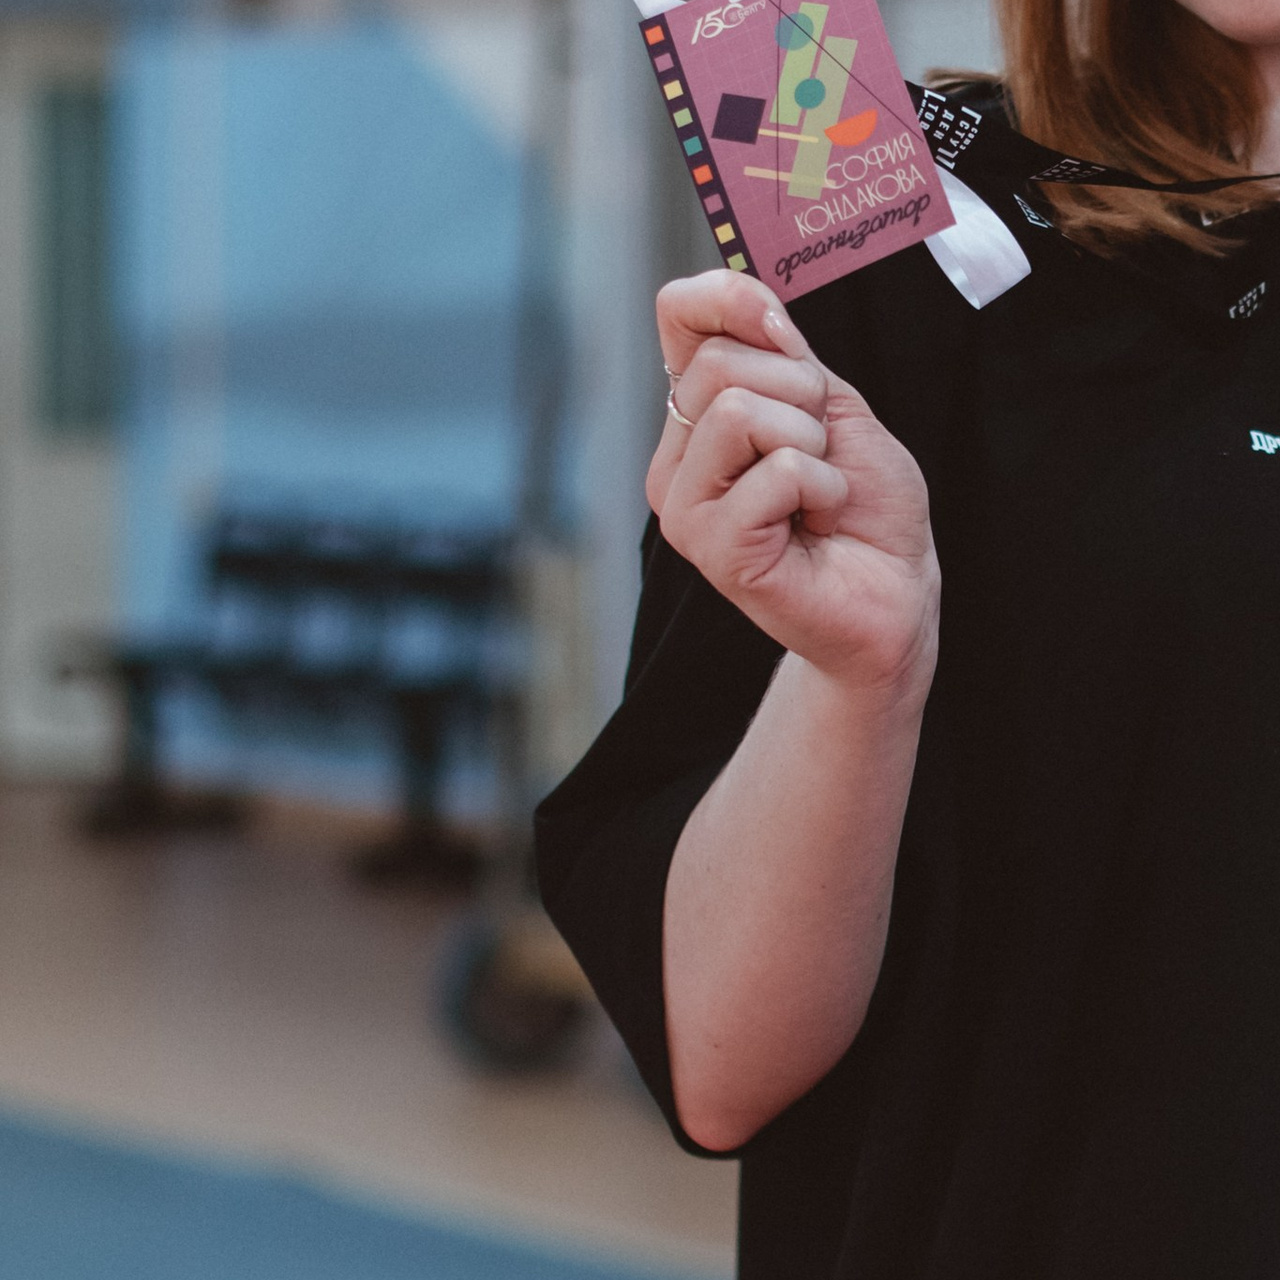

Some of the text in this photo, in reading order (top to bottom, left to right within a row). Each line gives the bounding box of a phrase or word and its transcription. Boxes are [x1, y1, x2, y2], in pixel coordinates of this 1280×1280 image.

[691, 3, 746, 45] 150
[933, 109, 955, 140] ДЕН
[949, 120, 971, 147] СТУ
[824, 132, 916, 189] СОФИЯ
[794, 163, 926, 239] КОНДАКОВА
[775, 193, 931, 286] организатор
